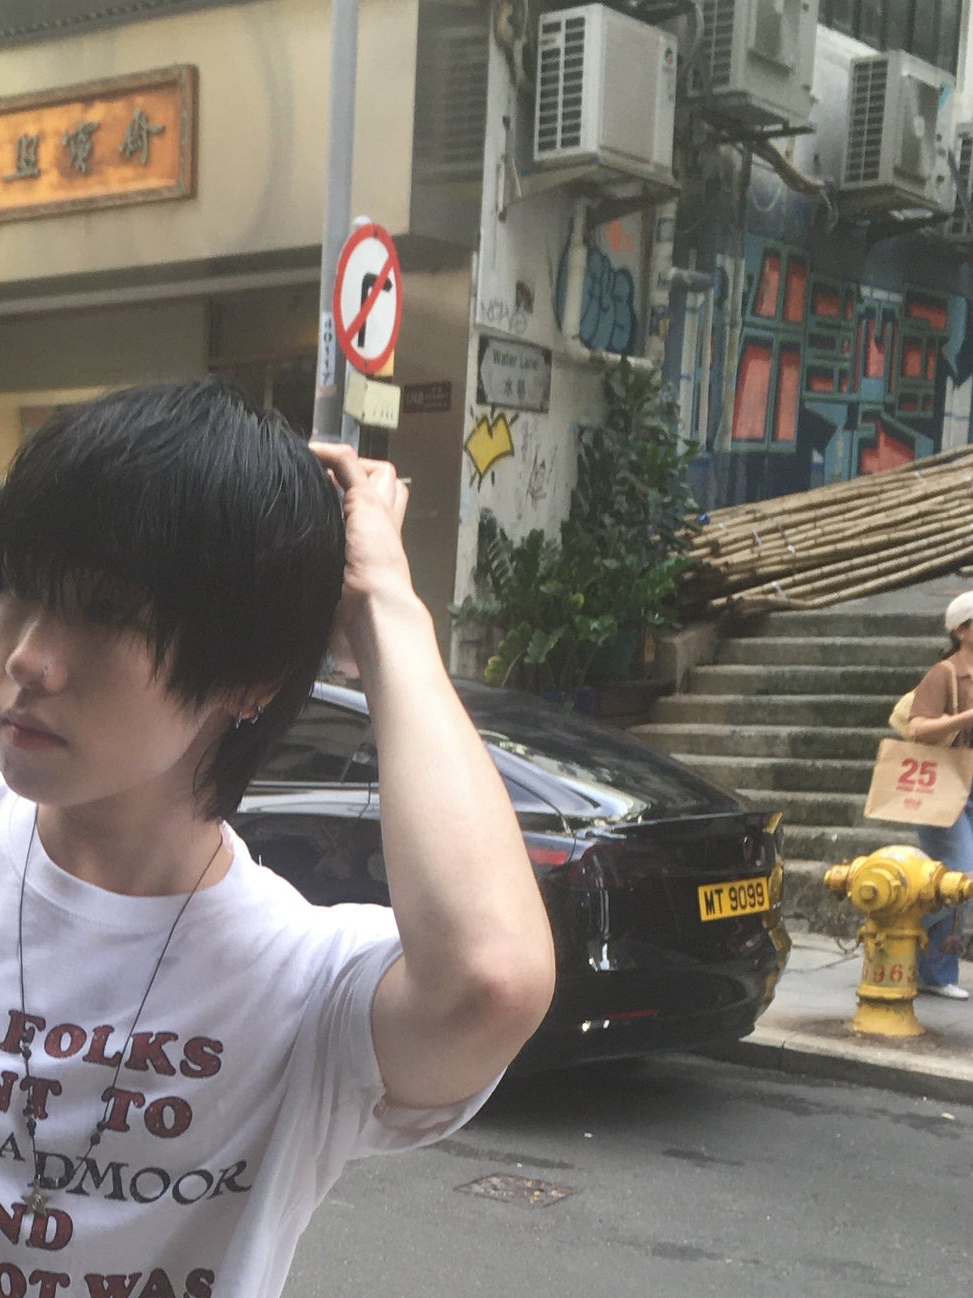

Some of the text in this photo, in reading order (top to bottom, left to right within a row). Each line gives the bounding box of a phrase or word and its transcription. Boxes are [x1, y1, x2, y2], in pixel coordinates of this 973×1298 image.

[898, 757, 938, 787] 25
[704, 882, 765, 915] MT 9099
[102, 1086, 193, 1138] TO
